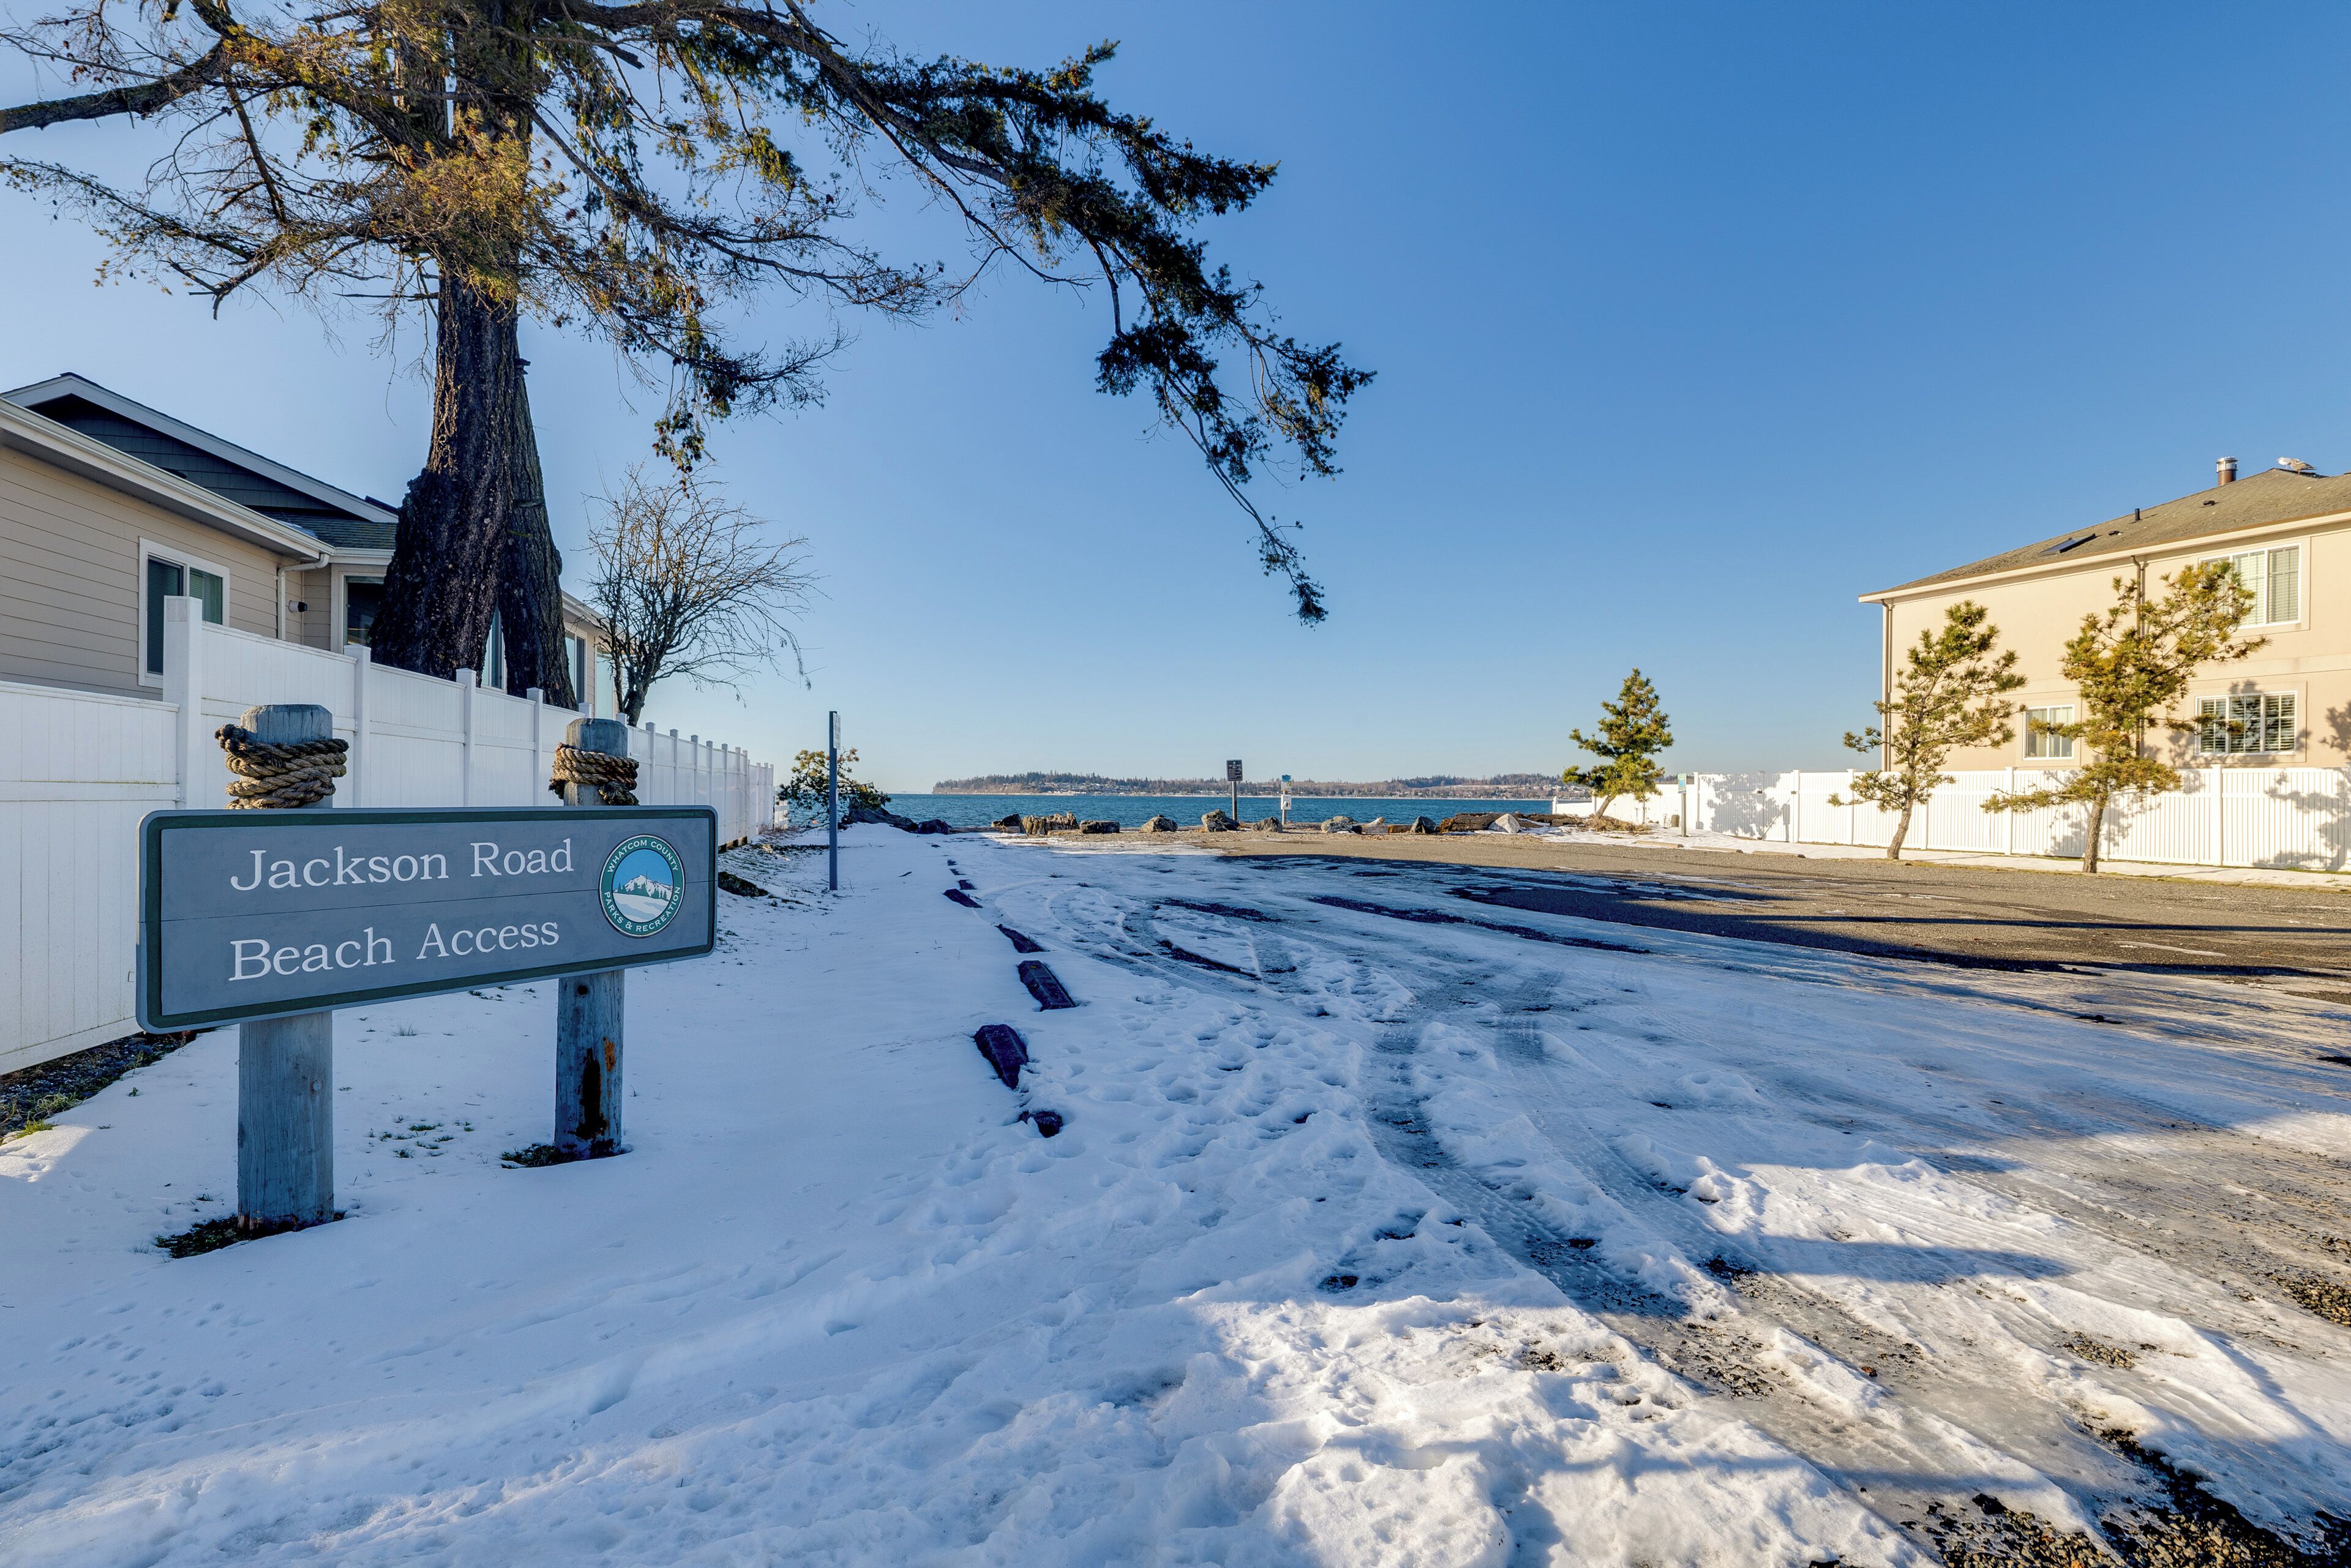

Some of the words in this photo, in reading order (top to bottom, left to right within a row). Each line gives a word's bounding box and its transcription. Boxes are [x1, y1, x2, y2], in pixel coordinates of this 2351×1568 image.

[230, 846, 449, 890] Jackson
[470, 838, 574, 877] Road
[607, 840, 647, 873] WHATCOM
[651, 841, 678, 871] COUNTY
[604, 891, 623, 923] PARKS
[625, 921, 632, 930] &
[636, 887, 681, 932] RECREATION
[228, 927, 396, 981] Beach
[416, 921, 559, 959] Access
